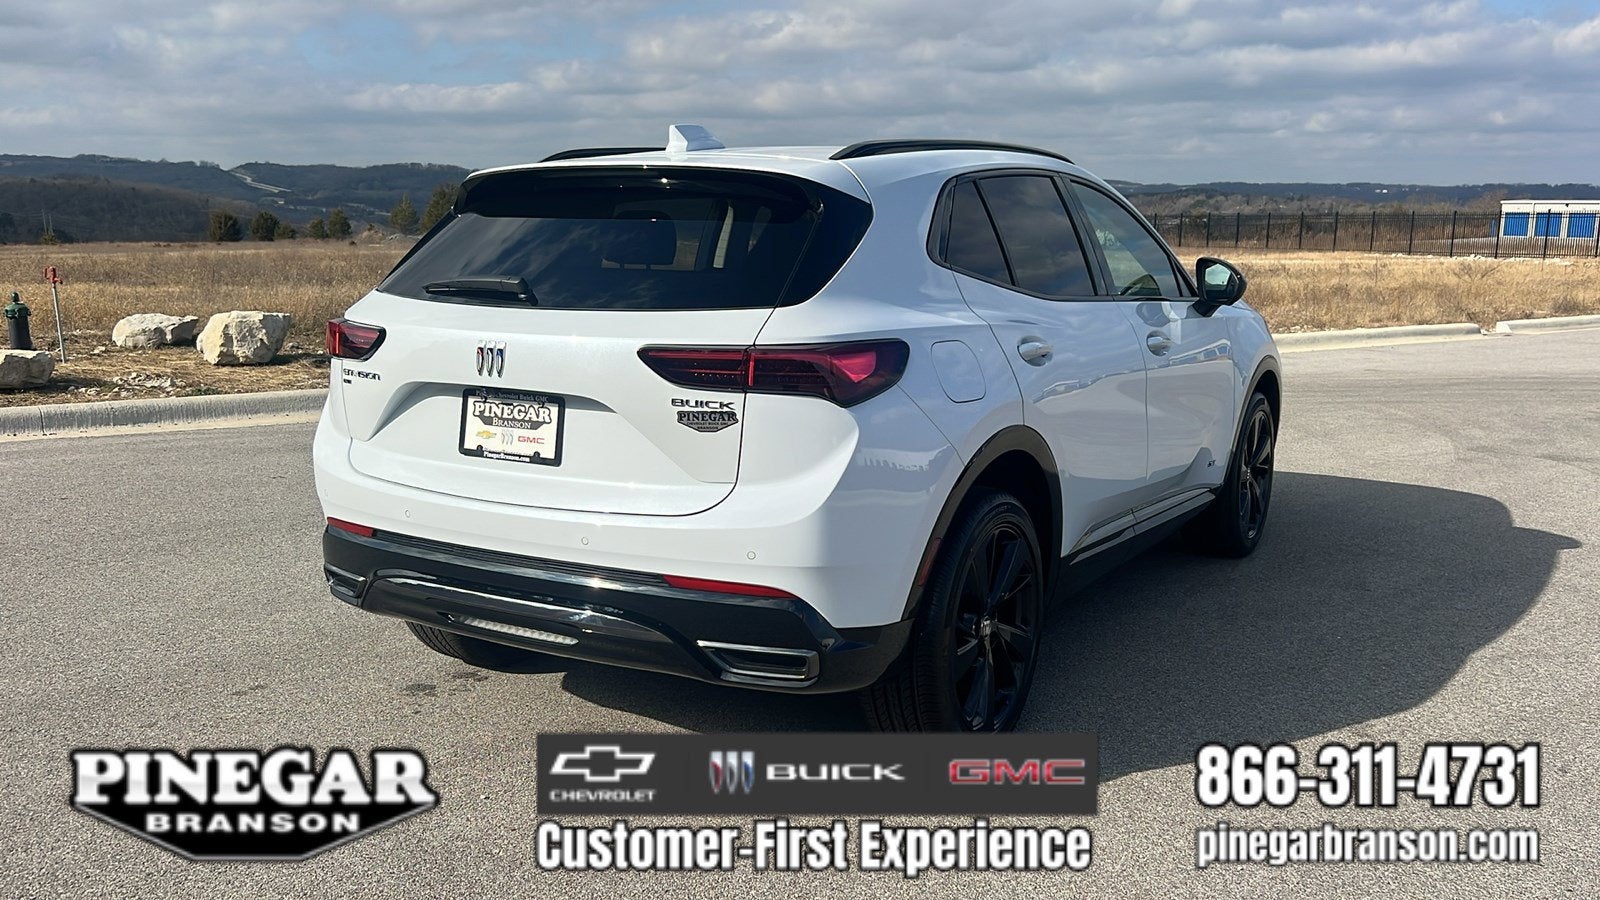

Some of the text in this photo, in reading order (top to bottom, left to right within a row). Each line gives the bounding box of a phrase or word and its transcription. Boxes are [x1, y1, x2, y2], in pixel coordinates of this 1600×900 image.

[671, 398, 736, 411] BUICK
[473, 401, 552, 424] PINEGAR
[678, 411, 736, 422] PINEGAR
[492, 417, 532, 429] BRANSON
[517, 435, 545, 445] GMC
